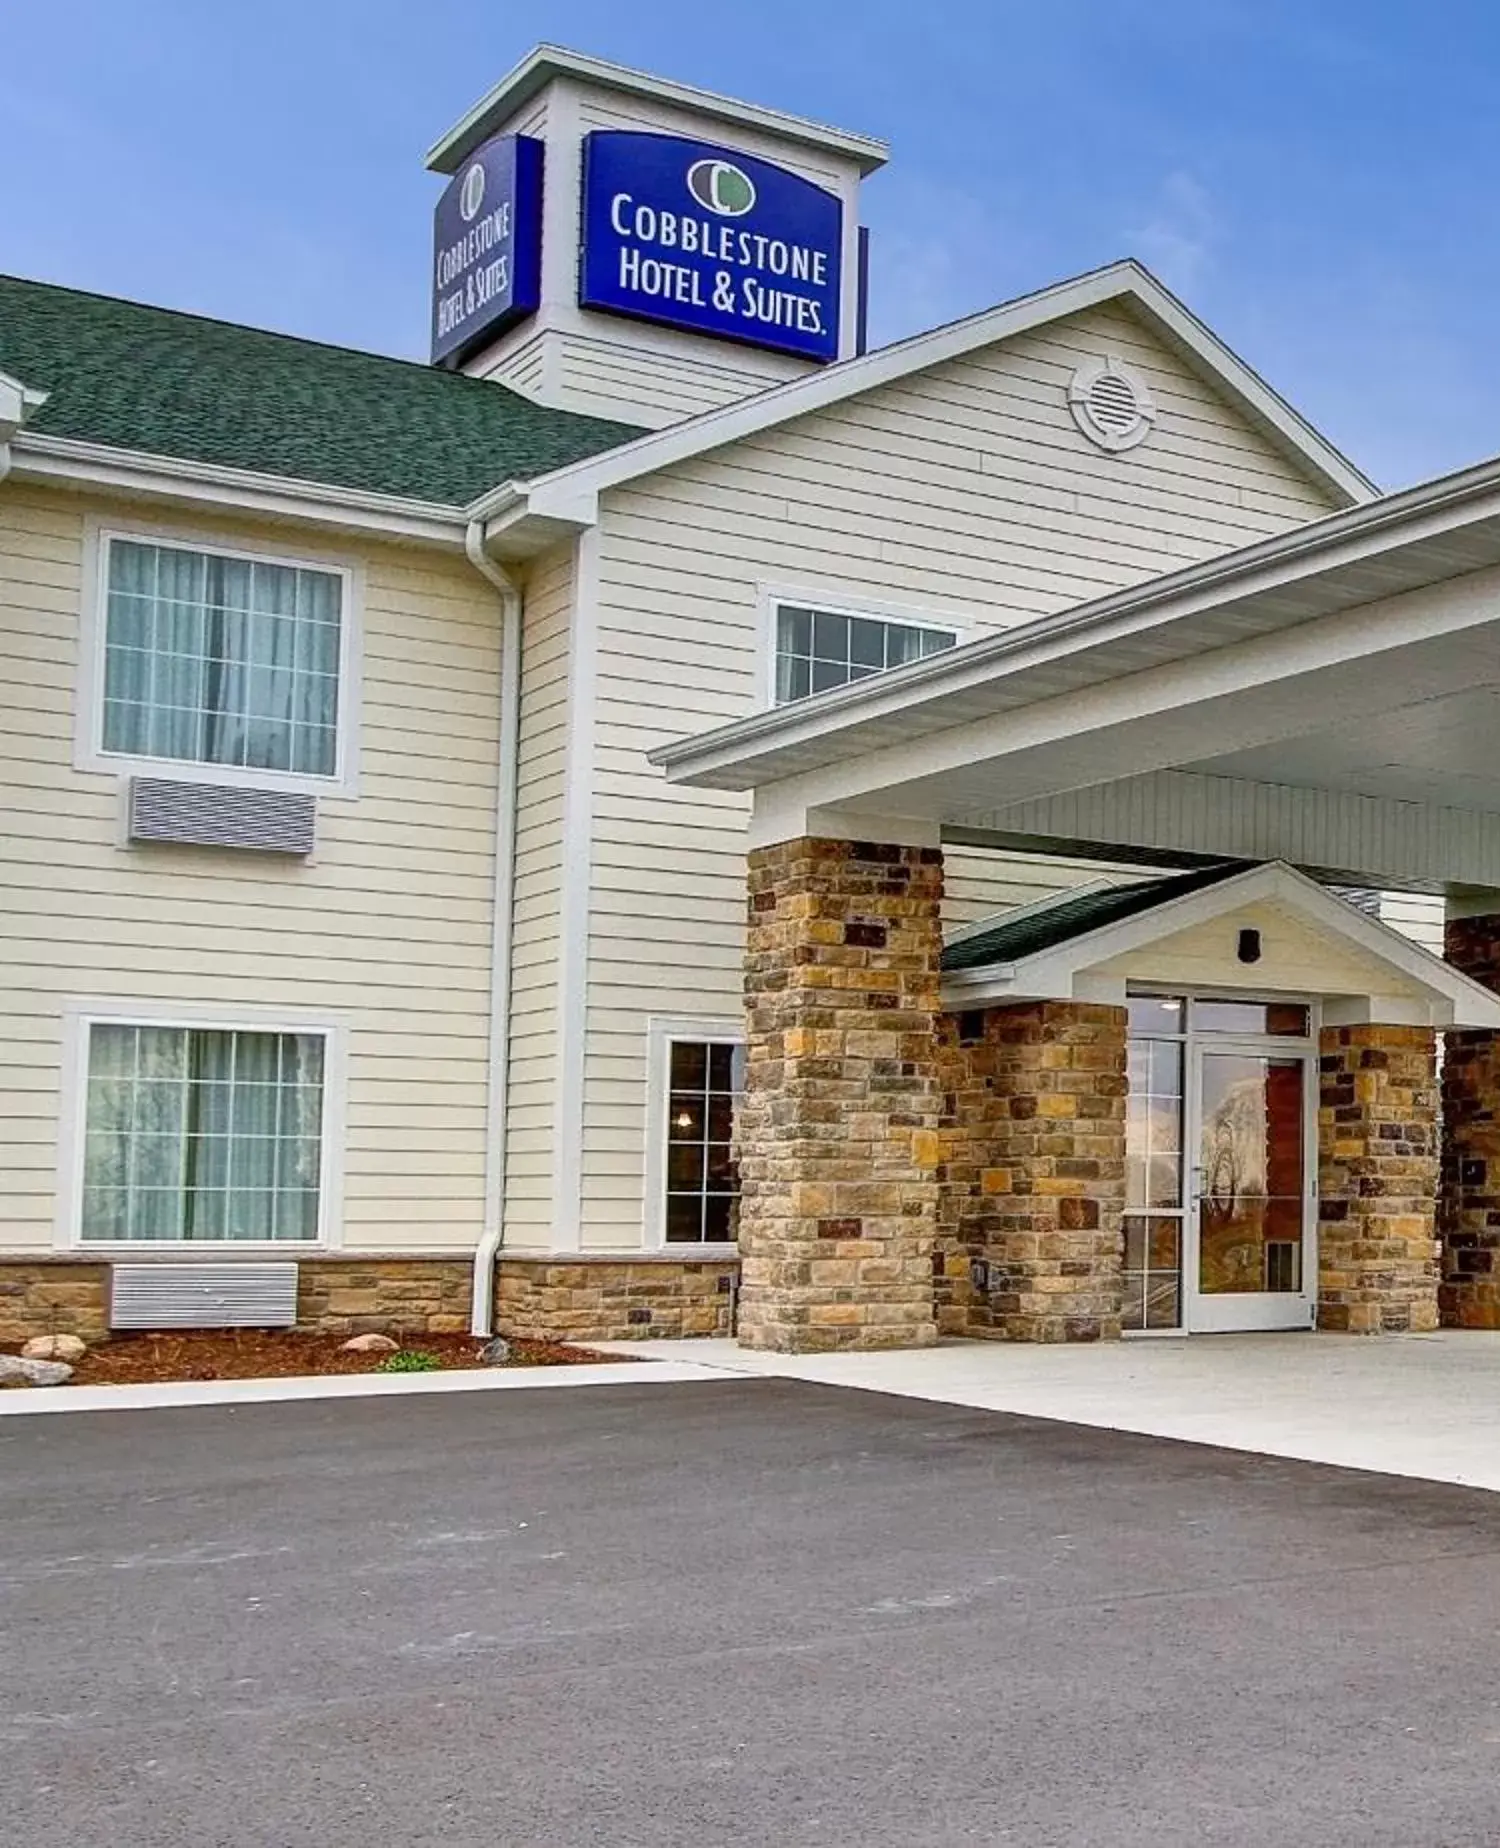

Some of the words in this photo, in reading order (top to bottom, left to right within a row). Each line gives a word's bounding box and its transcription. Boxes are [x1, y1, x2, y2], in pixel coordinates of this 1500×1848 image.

[436, 202, 510, 290] COBBLESTONE
[611, 193, 828, 286] COBBLESTONE
[437, 288, 466, 339] HOTEL
[619, 246, 706, 307] HOTEL
[712, 271, 735, 314] &
